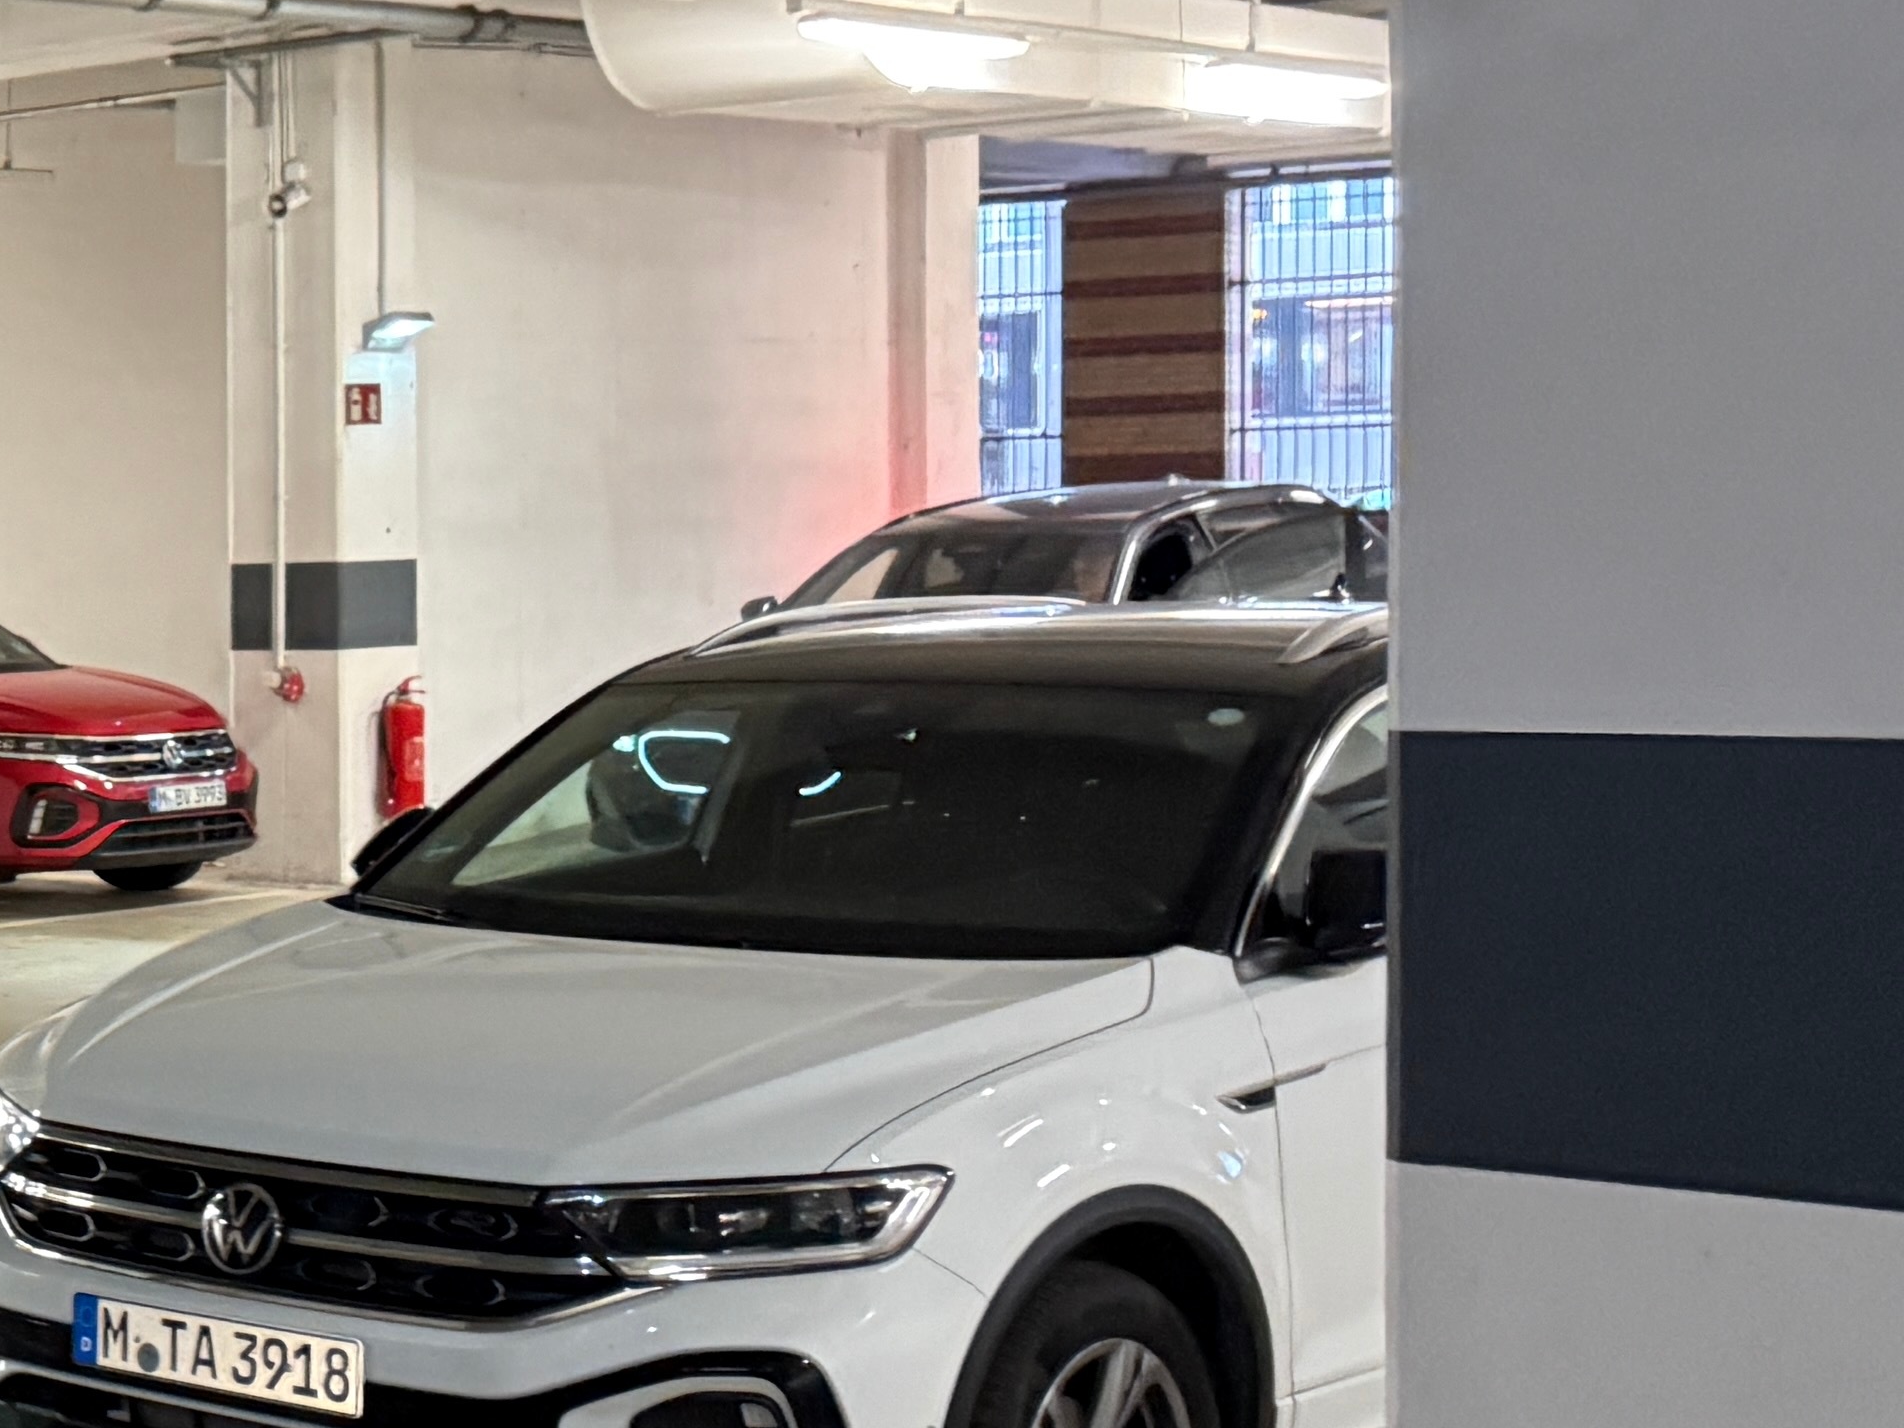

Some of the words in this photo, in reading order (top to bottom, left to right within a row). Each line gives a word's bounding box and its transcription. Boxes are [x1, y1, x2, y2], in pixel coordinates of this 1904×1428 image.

[101, 1306, 129, 1363] M
[161, 1317, 218, 1380] TA
[231, 1331, 351, 1404] 3918
